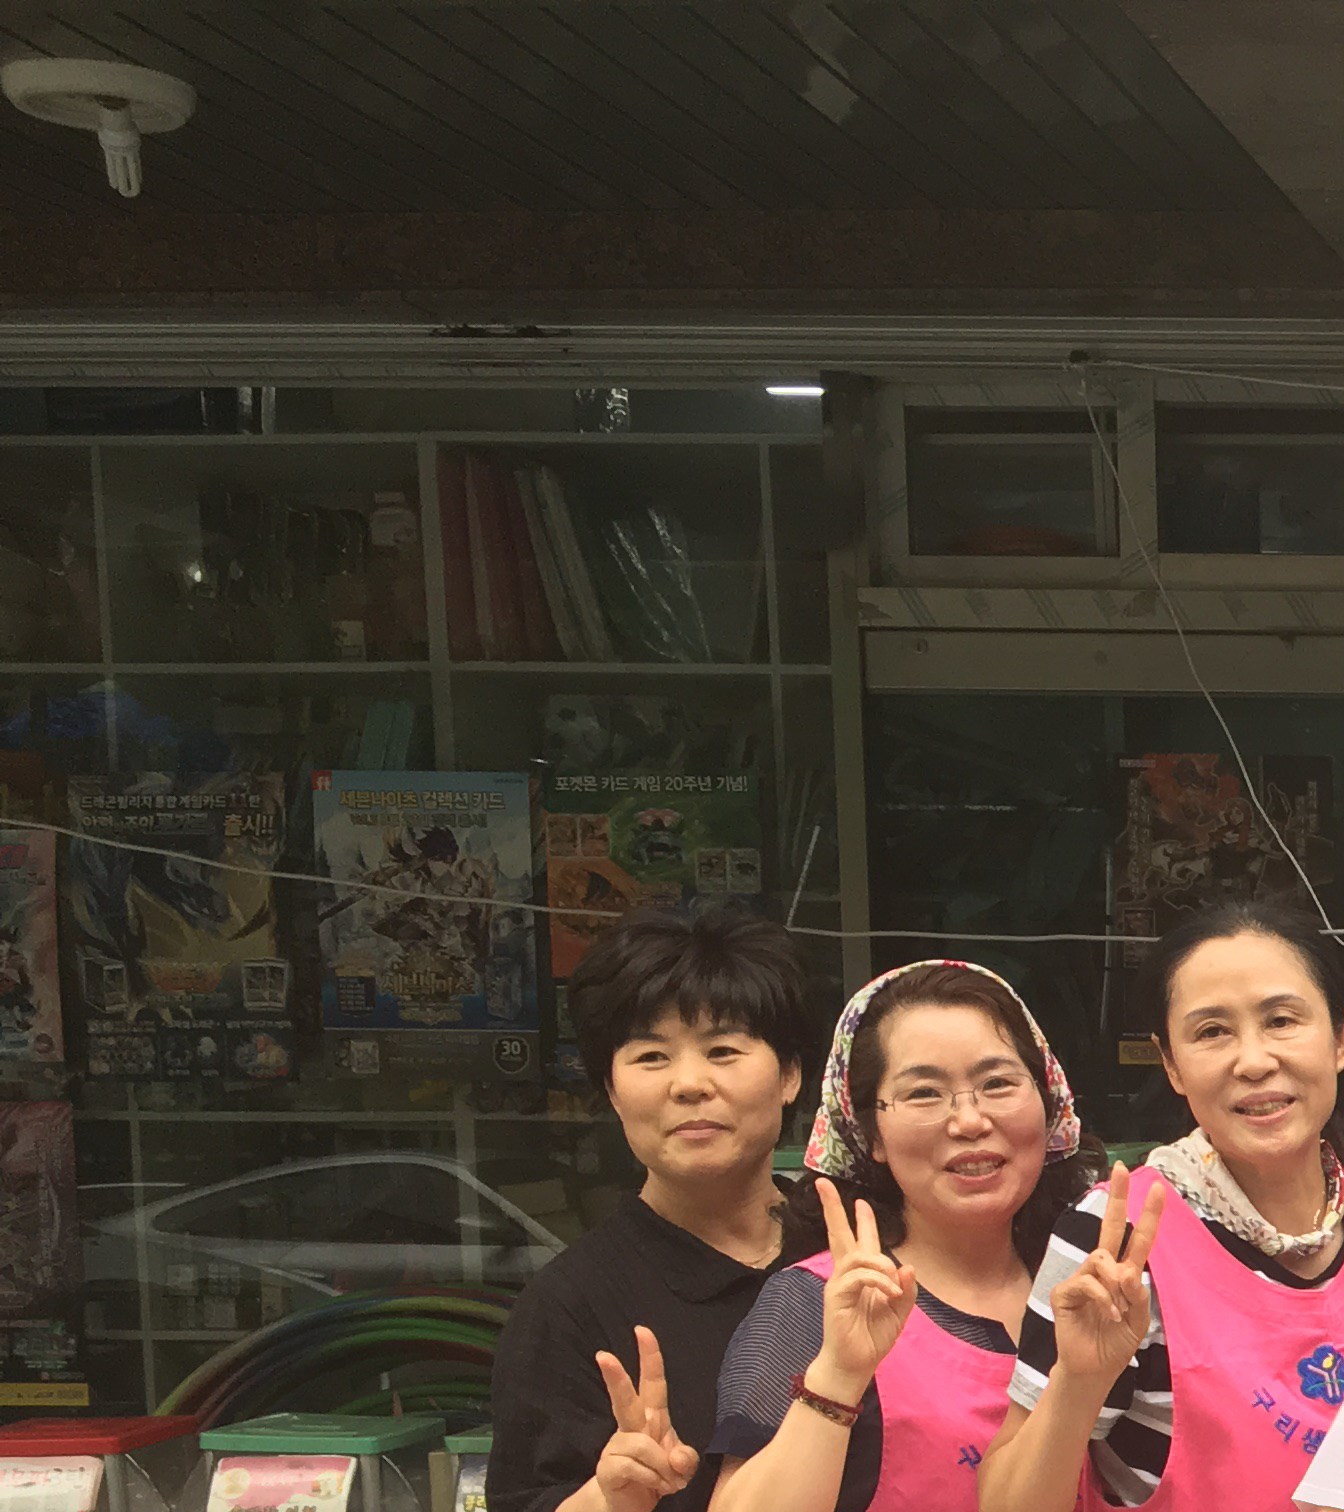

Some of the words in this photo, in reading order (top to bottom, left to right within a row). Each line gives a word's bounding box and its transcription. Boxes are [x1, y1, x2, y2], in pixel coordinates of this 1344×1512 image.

[555, 776, 598, 792] 포켓몬
[601, 776, 629, 792] 카드
[633, 776, 660, 792] 게임
[665, 776, 712, 792] 20주년
[716, 776, 748, 792] 기념!
